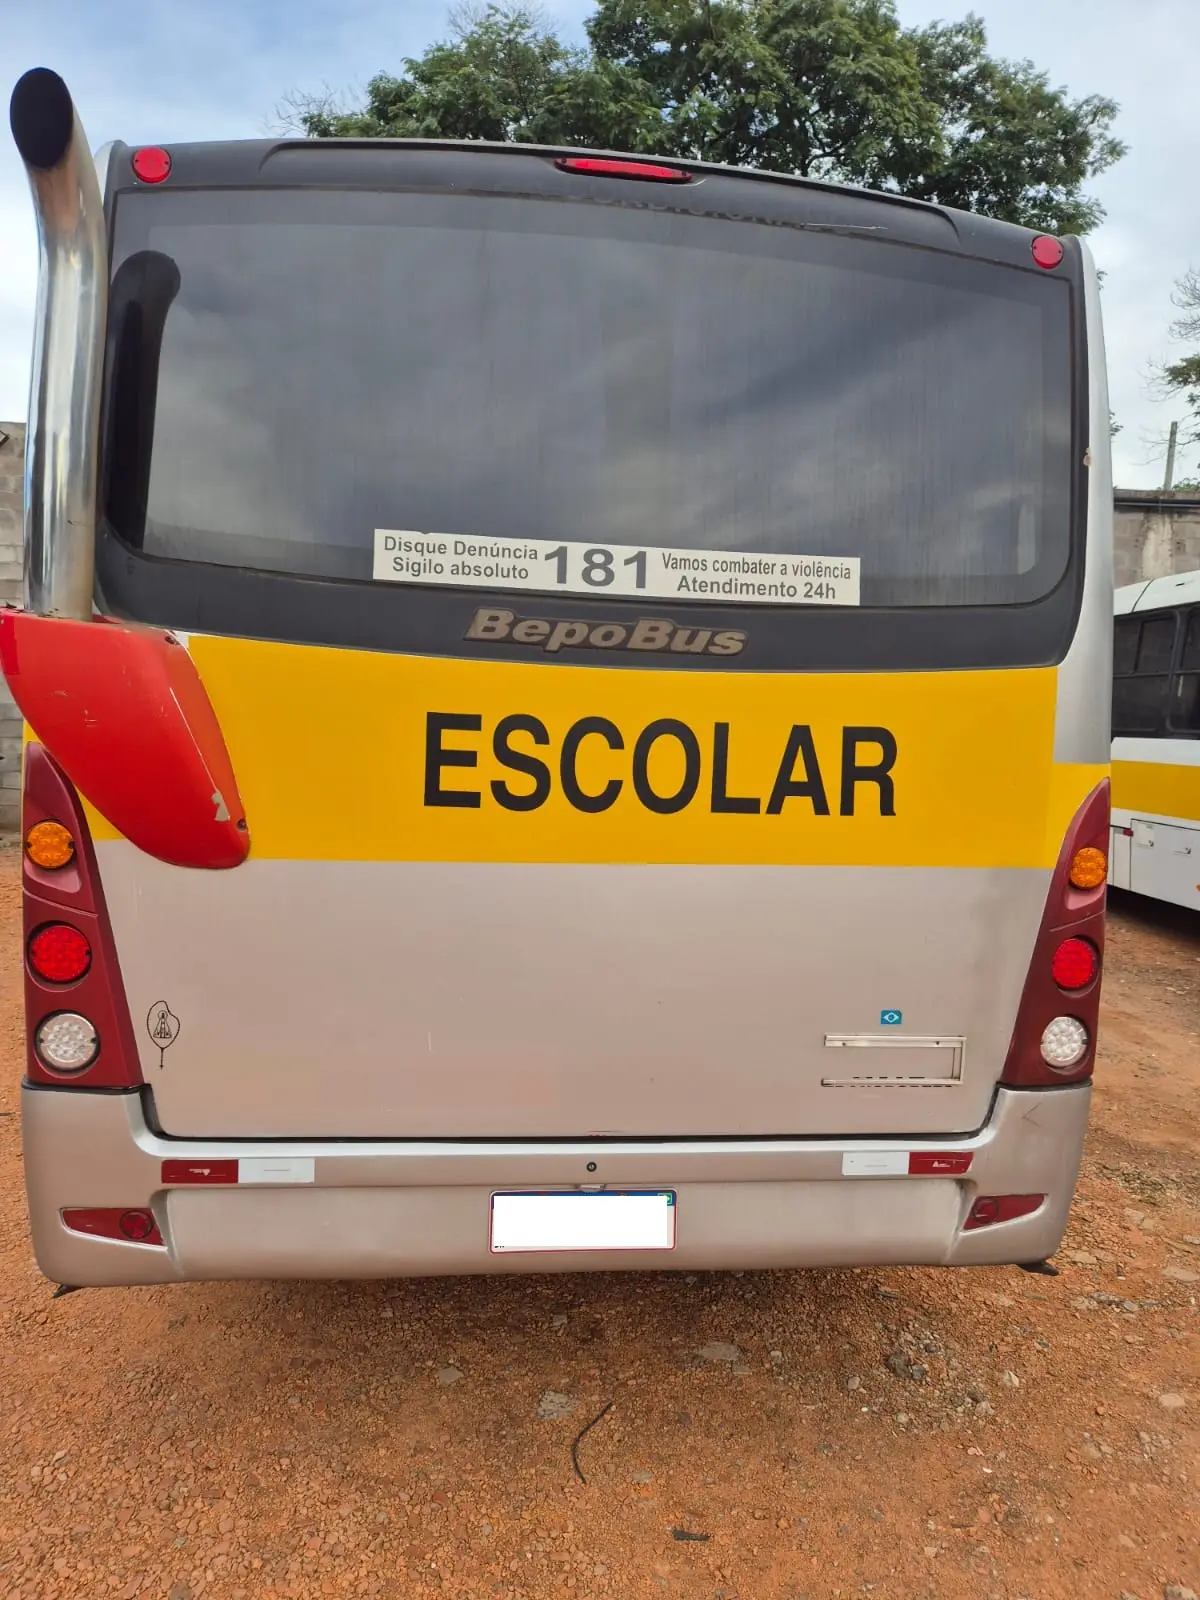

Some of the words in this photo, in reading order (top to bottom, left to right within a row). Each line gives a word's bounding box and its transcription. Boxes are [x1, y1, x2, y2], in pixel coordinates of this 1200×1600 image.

[384, 536, 447, 556] Disque
[453, 540, 538, 560] Denúncia
[393, 556, 444, 576] Sigilo
[450, 562, 529, 580] absoluto
[545, 546, 647, 588] 181
[662, 553, 708, 571] Vamos
[712, 557, 777, 575] combater
[780, 564, 788, 576] a
[792, 558, 851, 580] violência
[677, 576, 797, 597] Atendimento
[803, 582, 836, 600] 24h
[466, 608, 747, 655] BepoBus
[424, 712, 897, 816] ESCOLAR
